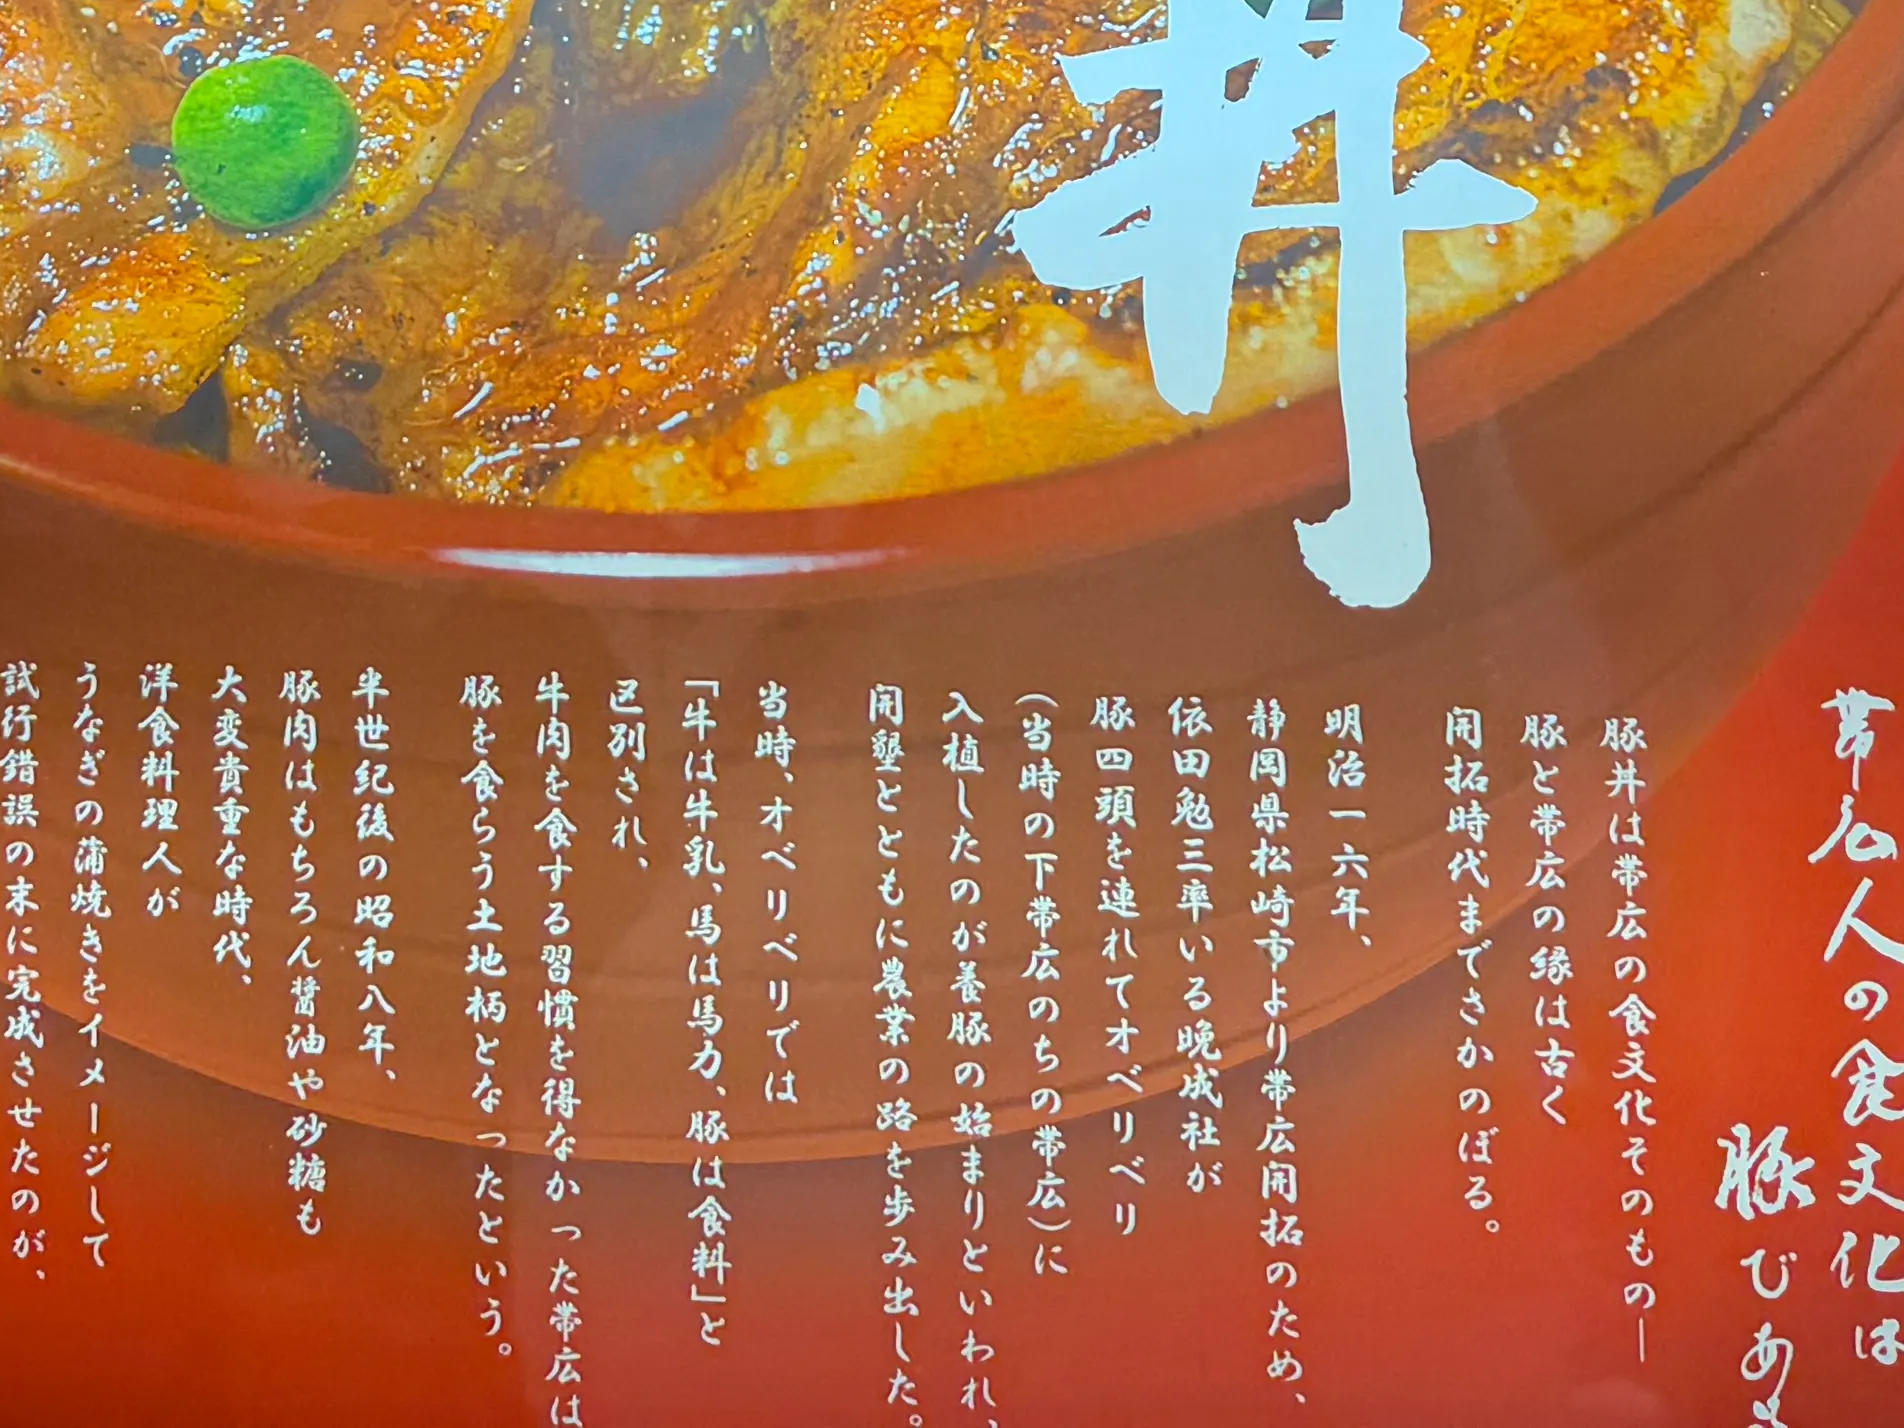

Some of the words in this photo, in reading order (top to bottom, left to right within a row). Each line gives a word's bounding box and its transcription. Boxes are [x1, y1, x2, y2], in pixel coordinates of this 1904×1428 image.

[0, 661, 45, 1278] 試行錯誤の末に完成させたのが、
[71, 662, 111, 1266] うなぎの蒲焼きをイメージして
[138, 663, 182, 917] 洋食料理人が
[212, 666, 253, 984] 大変貴重な時代、
[279, 670, 327, 1235] 豚肉はもちろん醤油や砂糖も
[352, 667, 395, 1080] 半世紀後の昭和八年、
[460, 675, 511, 1355] 豚を食らう土地柄となったという。
[608, 679, 648, 869] 区別され、
[682, 680, 732, 1345] 「牛は牛乳、馬は馬力、豚は食料」と
[755, 681, 800, 1103] 当時、オベリベリでは
[1168, 697, 1223, 1192] 依田勉三率いる晩成社が
[1324, 704, 1371, 947] 明治一六年、
[1444, 706, 1499, 1232] 開拓時代までさかのぼる。
[1520, 714, 1575, 1124] 豚と帯広の縁は古く
[534, 671, 582, 1428] 牛肉を食する習慣を得なかった帯広は
[869, 684, 922, 1427] 開墾とともに農業の路を歩み出した。
[1247, 698, 1305, 1403] 静岡県松崎市より帯広開拓のため、
